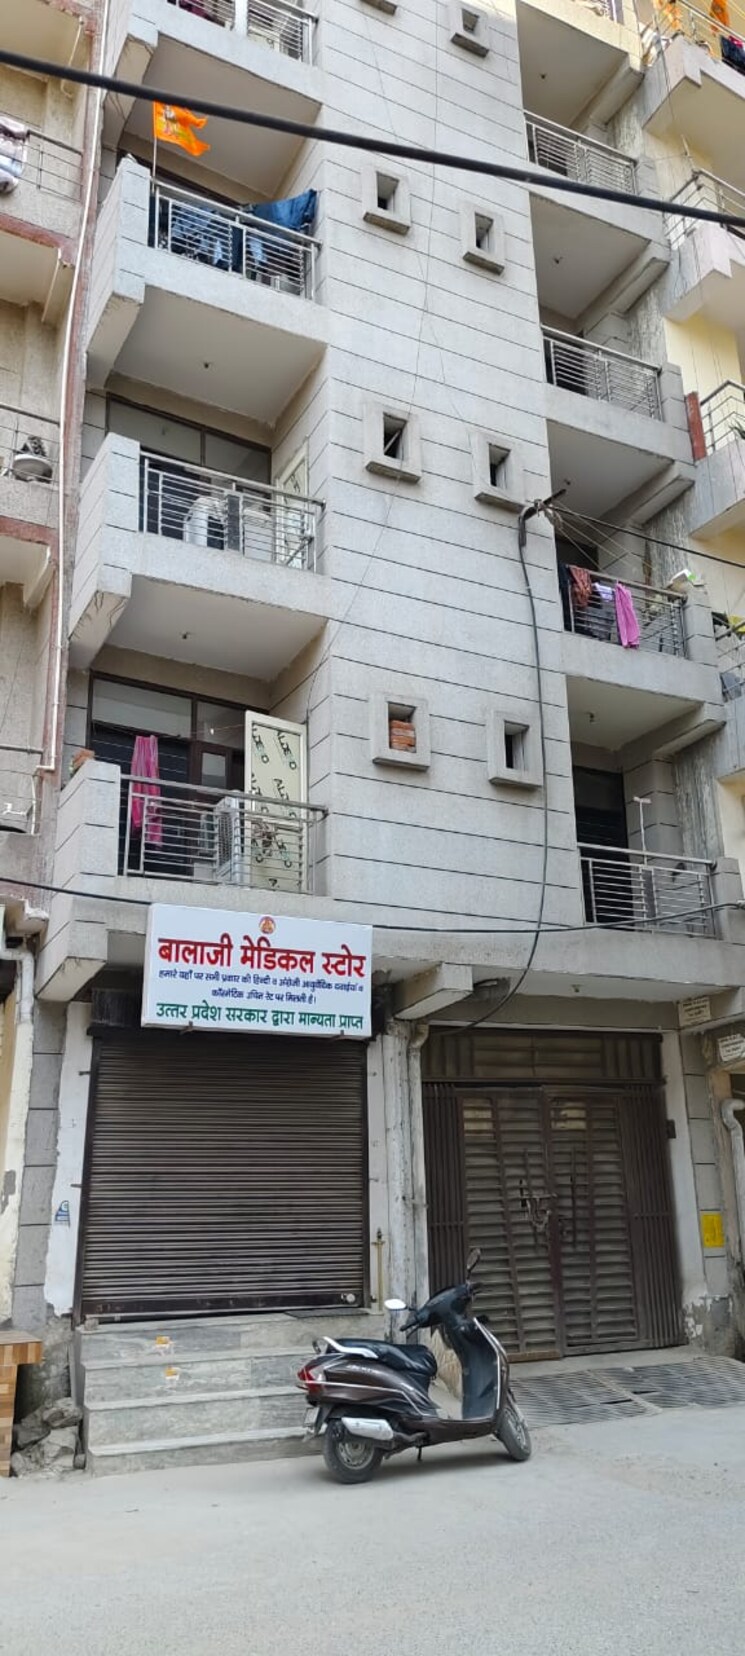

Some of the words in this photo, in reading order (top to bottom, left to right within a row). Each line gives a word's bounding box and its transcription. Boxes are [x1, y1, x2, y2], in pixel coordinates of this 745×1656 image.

[157, 932, 233, 967] बालाजी
[240, 934, 315, 973] मेडिकल
[322, 944, 366, 978] स्टोर
[158, 968, 179, 979] हमारे
[194, 972, 204, 981] पर
[204, 970, 221, 982] सभी
[221, 973, 241, 984] प्रकार
[252, 973, 272, 986] हिन्दी
[245, 989, 265, 1001] उचित
[264, 990, 275, 1001] रेट
[274, 993, 285, 1003] पर
[284, 991, 308, 1004] मिलती
[156, 1002, 188, 1019] उत्तर
[191, 1000, 222, 1020] प्रदेश
[225, 1008, 268, 1024] सरकार
[270, 1009, 295, 1027] द्वारा
[298, 1012, 337, 1028] मान्यता
[338, 1014, 364, 1030] प्राप्त
